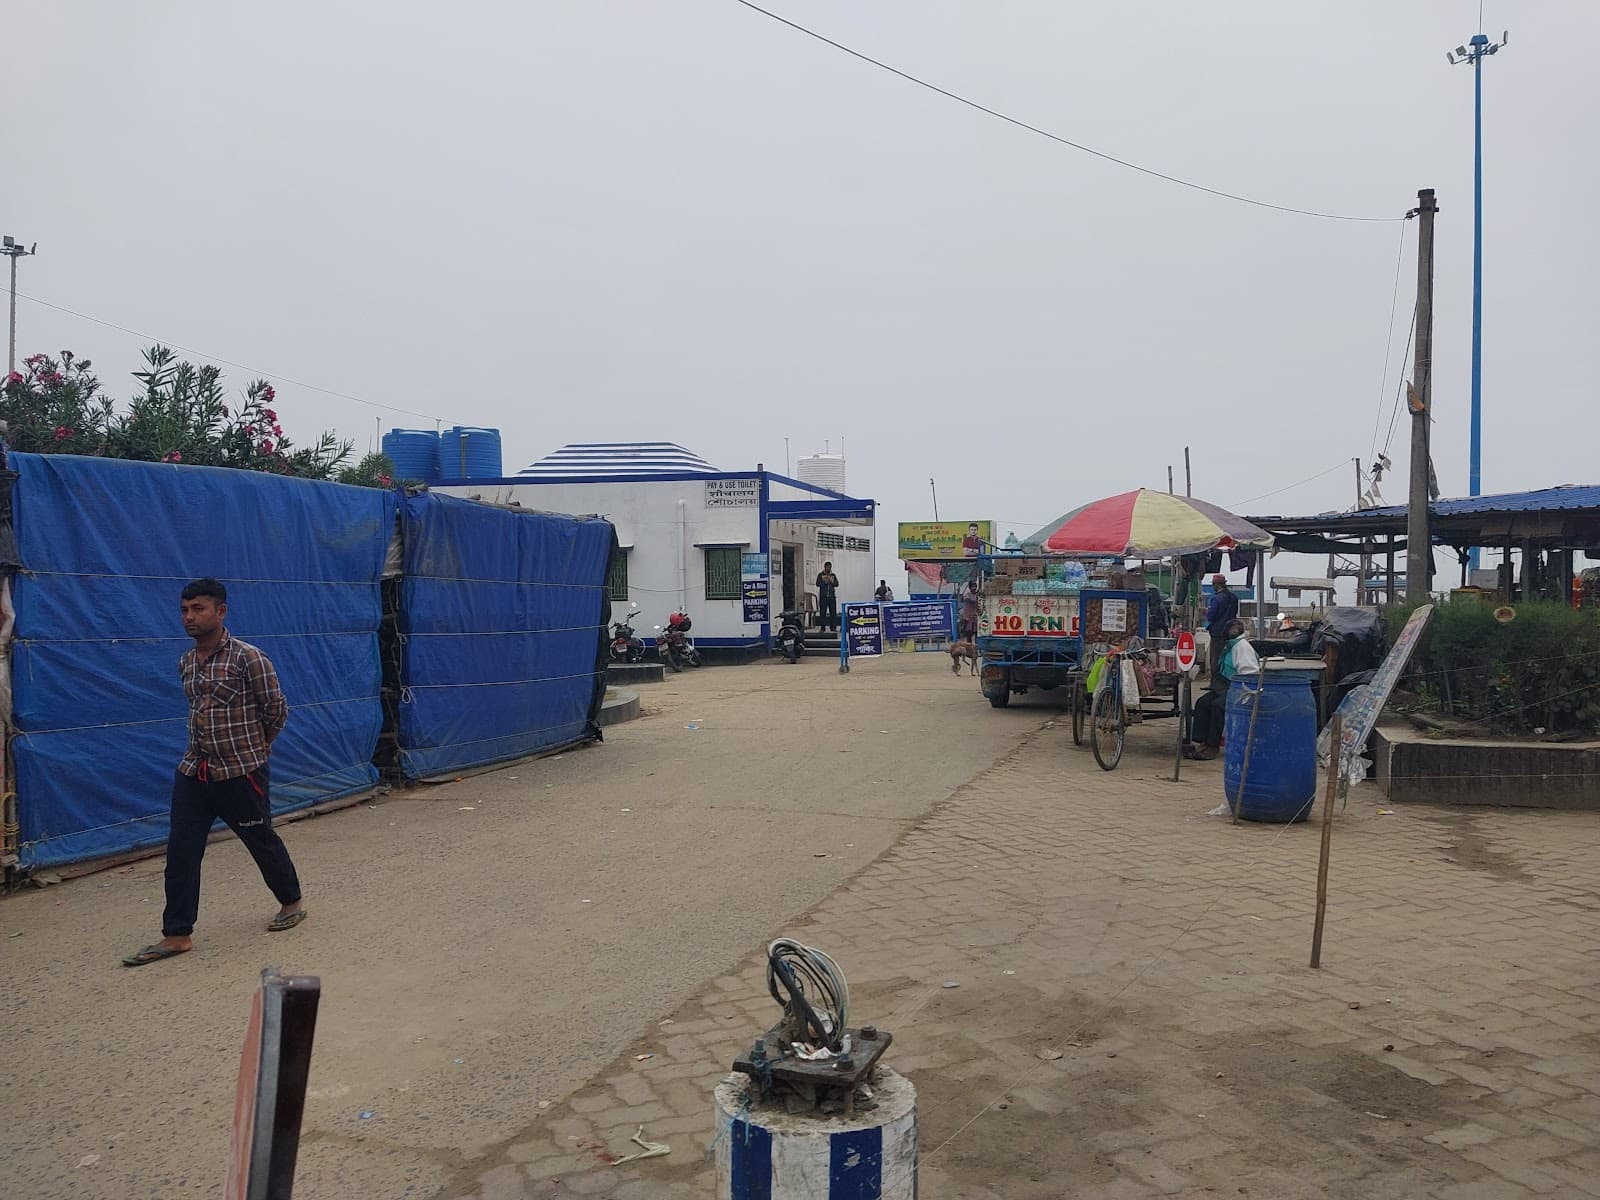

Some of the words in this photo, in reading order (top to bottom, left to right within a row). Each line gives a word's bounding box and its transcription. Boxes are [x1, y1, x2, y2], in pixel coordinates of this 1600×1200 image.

[706, 481, 717, 489] PAY
[718, 481, 723, 489] &
[725, 481, 736, 489] USE
[737, 480, 756, 488] TOILET
[850, 627, 880, 636] PARKING
